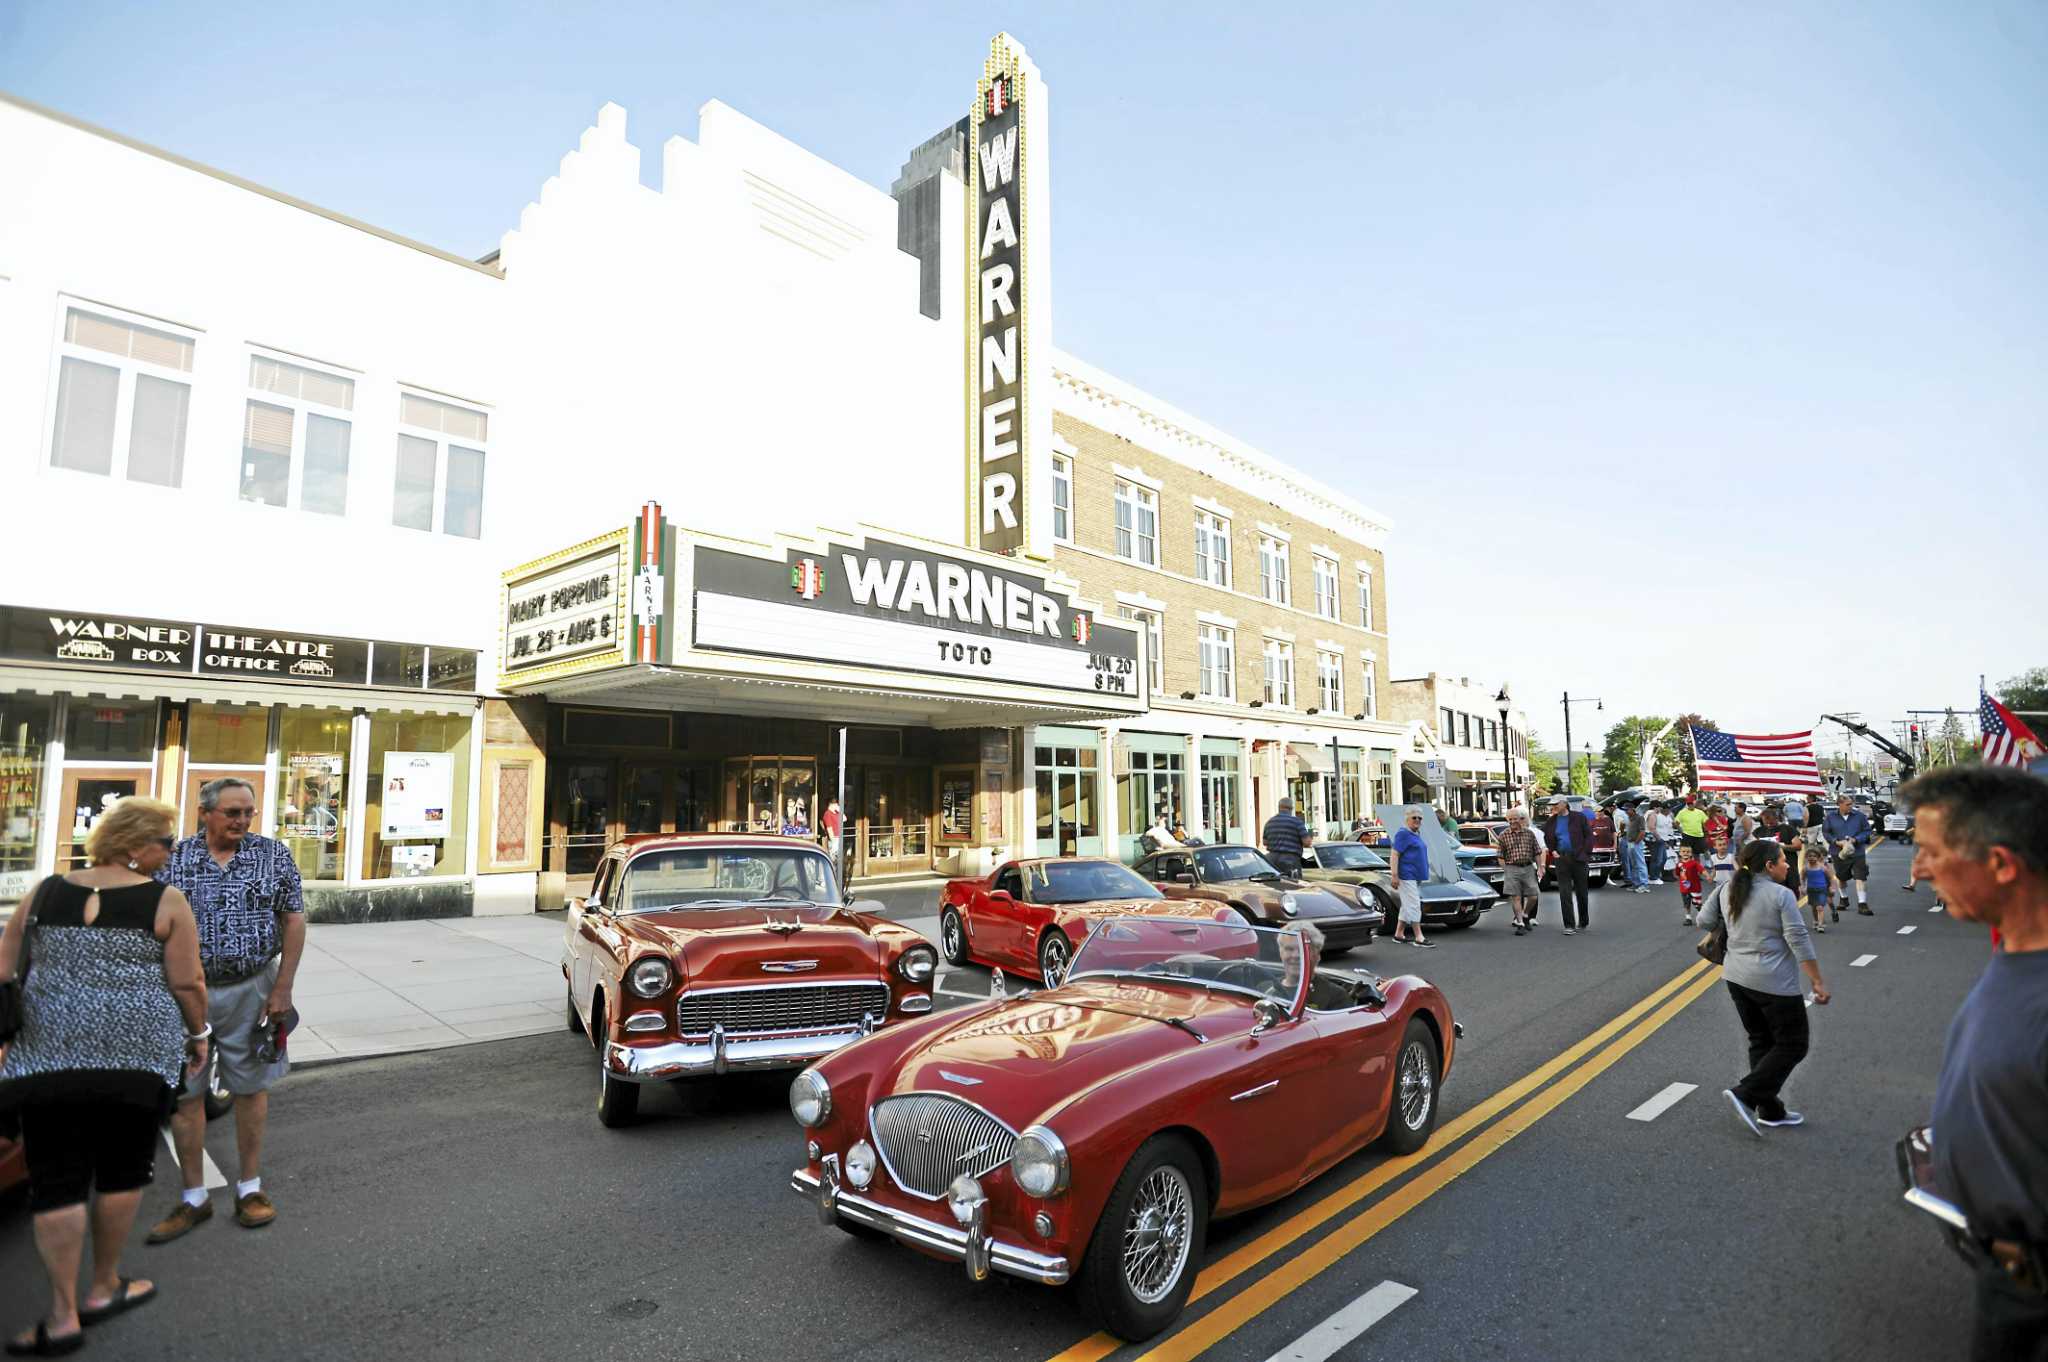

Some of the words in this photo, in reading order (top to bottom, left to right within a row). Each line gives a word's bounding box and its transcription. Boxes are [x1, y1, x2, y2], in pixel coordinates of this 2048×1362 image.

[980, 125, 1019, 535] WARNER
[509, 594, 546, 625] MARY
[551, 574, 610, 613] POPPINS
[841, 553, 1063, 639] WARNER
[49, 617, 191, 646] WARNER
[206, 633, 334, 659] THEATRE
[566, 618, 596, 646] AUG
[132, 648, 182, 664] BOX
[205, 654, 280, 671] OFFICE
[938, 641, 992, 665] TOTO
[1086, 654, 1111, 672] JUN
[1116, 658, 1132, 674] 20
[1095, 673, 1103, 690] 8
[1107, 675, 1125, 692] PM
